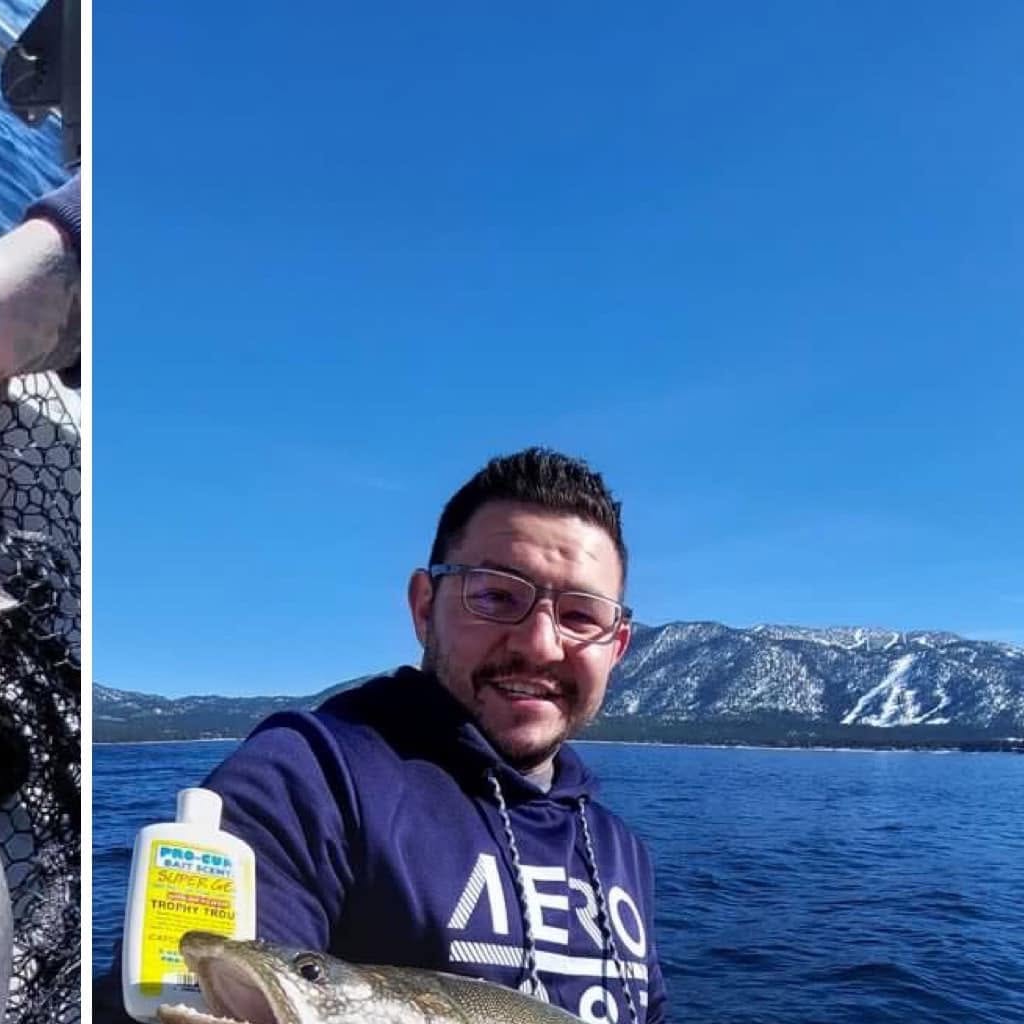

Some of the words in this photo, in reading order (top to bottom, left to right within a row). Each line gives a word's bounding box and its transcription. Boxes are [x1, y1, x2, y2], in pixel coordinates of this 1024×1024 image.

[160, 847, 232, 867] PRO-CUR
[157, 869, 208, 889] SUPER
[210, 878, 234, 893] GE
[151, 899, 199, 915] TROPHY
[204, 906, 235, 920] TROU
[447, 853, 647, 958] AERO
